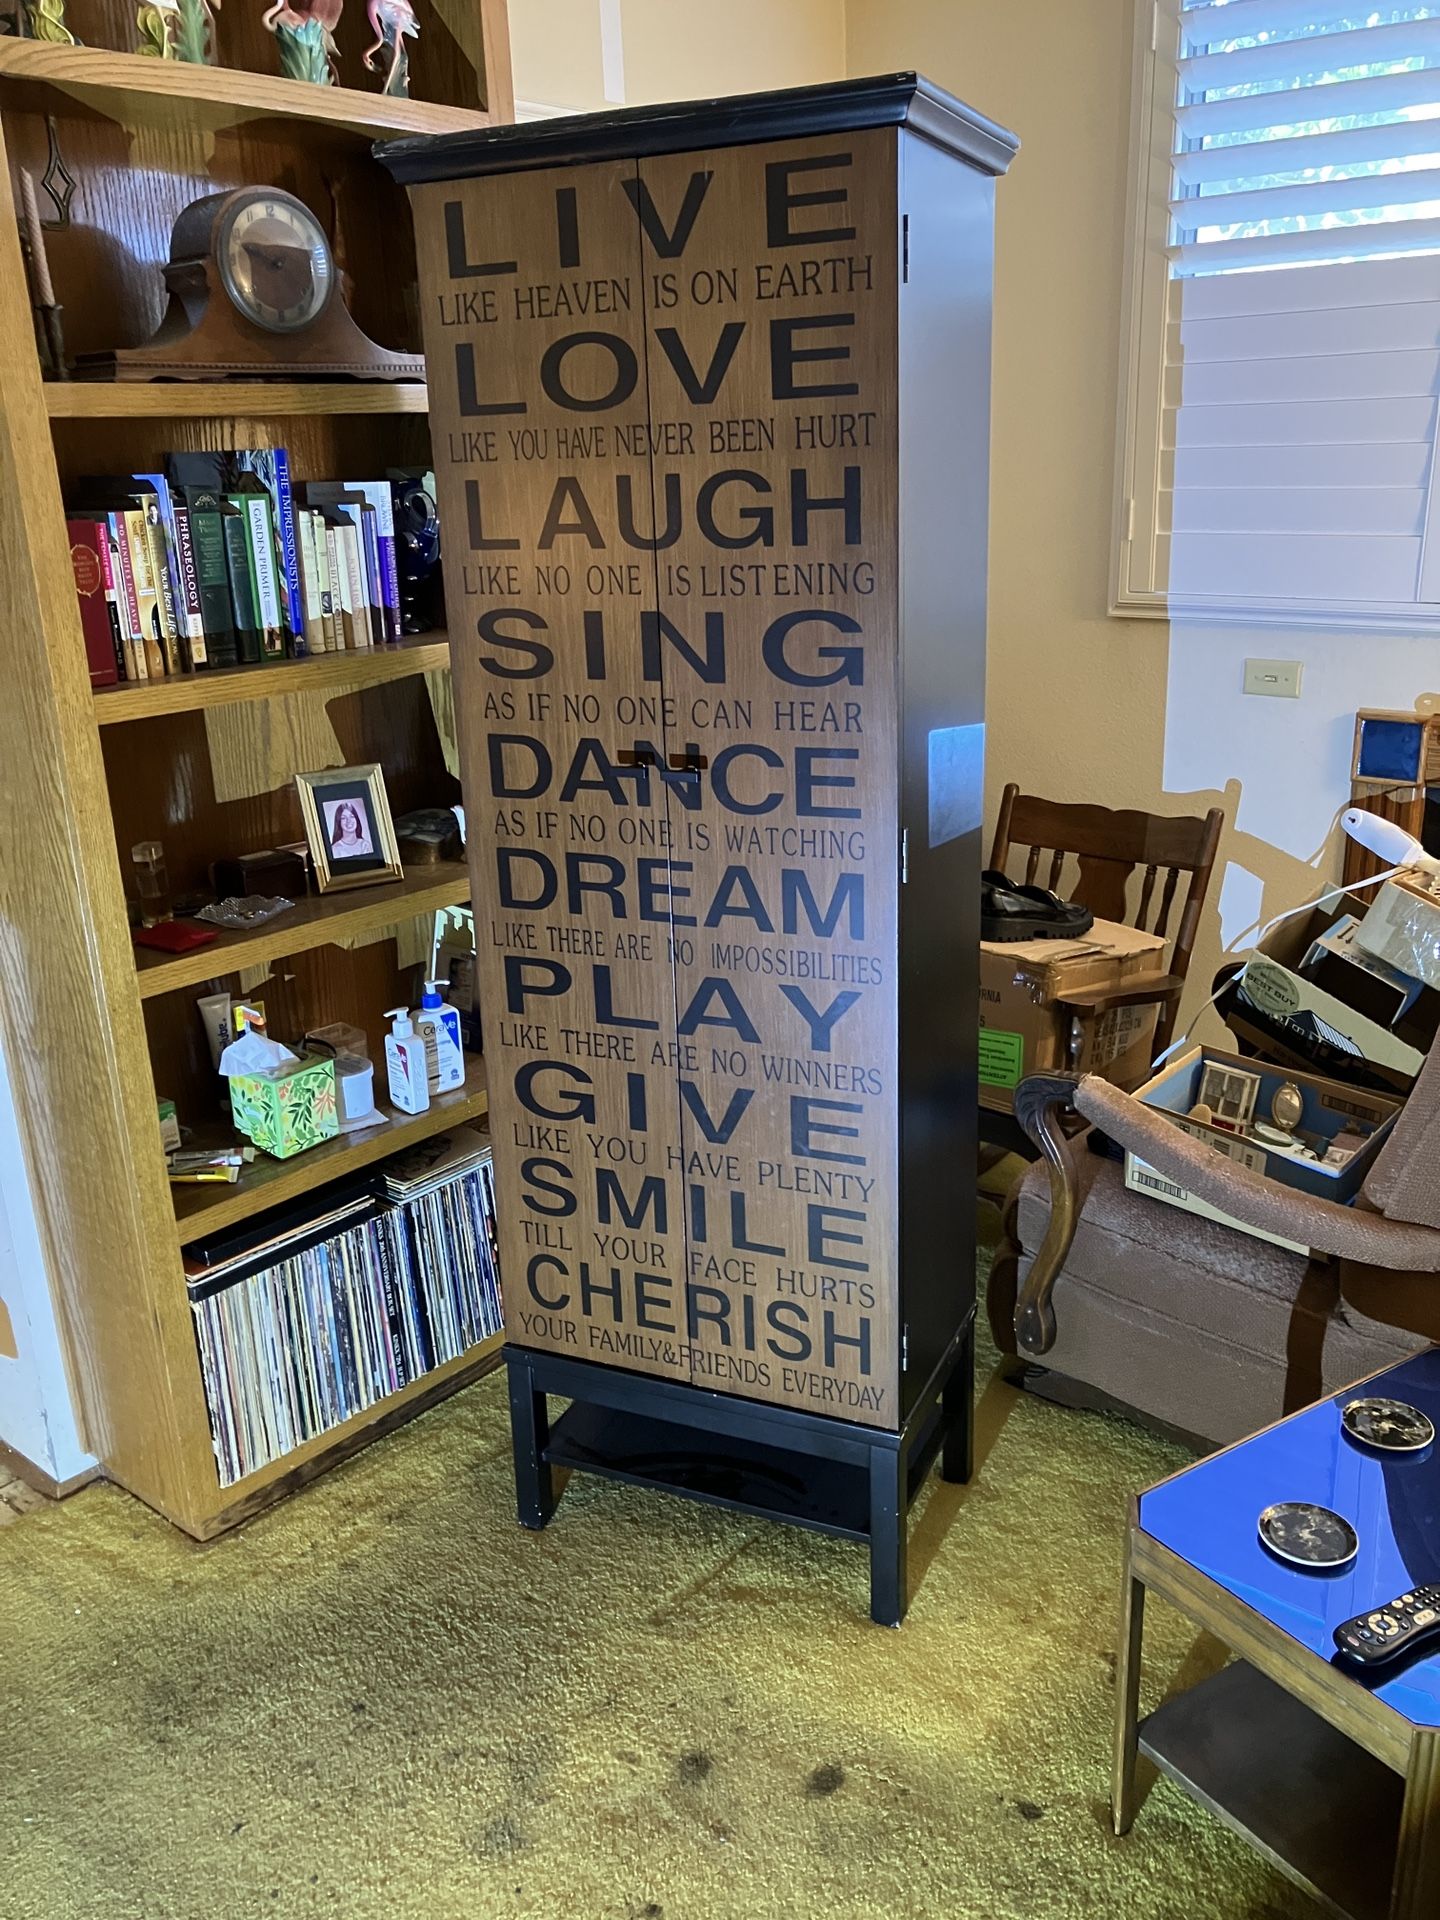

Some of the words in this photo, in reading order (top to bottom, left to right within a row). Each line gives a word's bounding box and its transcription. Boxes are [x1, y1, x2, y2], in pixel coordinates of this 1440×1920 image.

[444, 153, 856, 279] LIVE
[438, 291, 498, 326] LIKE
[514, 278, 631, 320] HEAVEN
[652, 273, 679, 309] IS
[691, 268, 738, 305] ON
[755, 255, 874, 300] EARTH
[455, 313, 859, 417] LOVE
[279, 464, 289, 490] THE
[449, 431, 498, 463] LIKE
[511, 429, 547, 460] YOU
[556, 427, 606, 459] HAVE
[615, 422, 694, 456] NEVER
[709, 419, 774, 453] BEEN
[795, 412, 876, 449] HURT
[282, 495, 299, 590] IMPRESSIONISTS
[465, 466, 862, 550] LAUGH
[120, 540, 131, 580] MINUTES
[129, 596, 139, 631] HEAVEN
[178, 515, 199, 609] PHRASEOLOGY
[253, 508, 264, 554] GARDEN
[259, 556, 271, 598] PRIMER
[462, 566, 521, 595] LIKE
[536, 566, 570, 595] NO
[586, 565, 642, 595] ONE
[667, 565, 691, 595] IS
[701, 562, 875, 597] LISTENING
[166, 612, 178, 633] Life
[477, 608, 864, 687] SING
[484, 692, 515, 721] AS
[528, 693, 551, 722] IF
[564, 695, 599, 724] NO
[617, 696, 676, 728] ONE
[691, 698, 753, 729] CAN
[775, 701, 863, 733] HEAR
[487, 733, 862, 820] DANCE
[495, 810, 526, 837] AS
[536, 811, 558, 839] IF
[569, 815, 605, 843] NO
[618, 818, 672, 849] ONE
[688, 823, 710, 851] IS
[725, 825, 866, 861] WATCHING
[496, 847, 865, 941] DREAM
[492, 921, 537, 950] LIKE
[546, 926, 605, 958] THERE
[615, 933, 652, 961] ARE
[668, 938, 694, 966] NO
[711, 943, 883, 985] IMPOSSIBILITIES
[1247, 972, 1275, 996] BEST
[1275, 989, 1296, 1006] BUY
[423, 1020, 456, 1036] CeraVe
[504, 955, 863, 1053] PLAY
[500, 1021, 548, 1051] LIKE
[560, 1028, 636, 1062] THERE
[651, 1042, 700, 1072] ARE
[712, 1048, 747, 1077] NO
[761, 1054, 883, 1095] WINNERS
[514, 1060, 867, 1167] GIVE
[513, 1123, 571, 1154] LIKE
[586, 1134, 647, 1166] YOU
[667, 1147, 741, 1182] HAVE
[758, 1160, 875, 1203] PLENTY
[520, 1157, 869, 1273] SMILE
[519, 1220, 573, 1251] TILL
[593, 1232, 666, 1268] YOUR
[690, 1251, 757, 1287] FACE
[776, 1268, 875, 1309] HURTS
[526, 1254, 871, 1376] CHERISH
[519, 1311, 578, 1345] YOUR
[589, 1326, 771, 1387] FAMILY&FRIENDS
[783, 1368, 884, 1411] EVERYDAY
